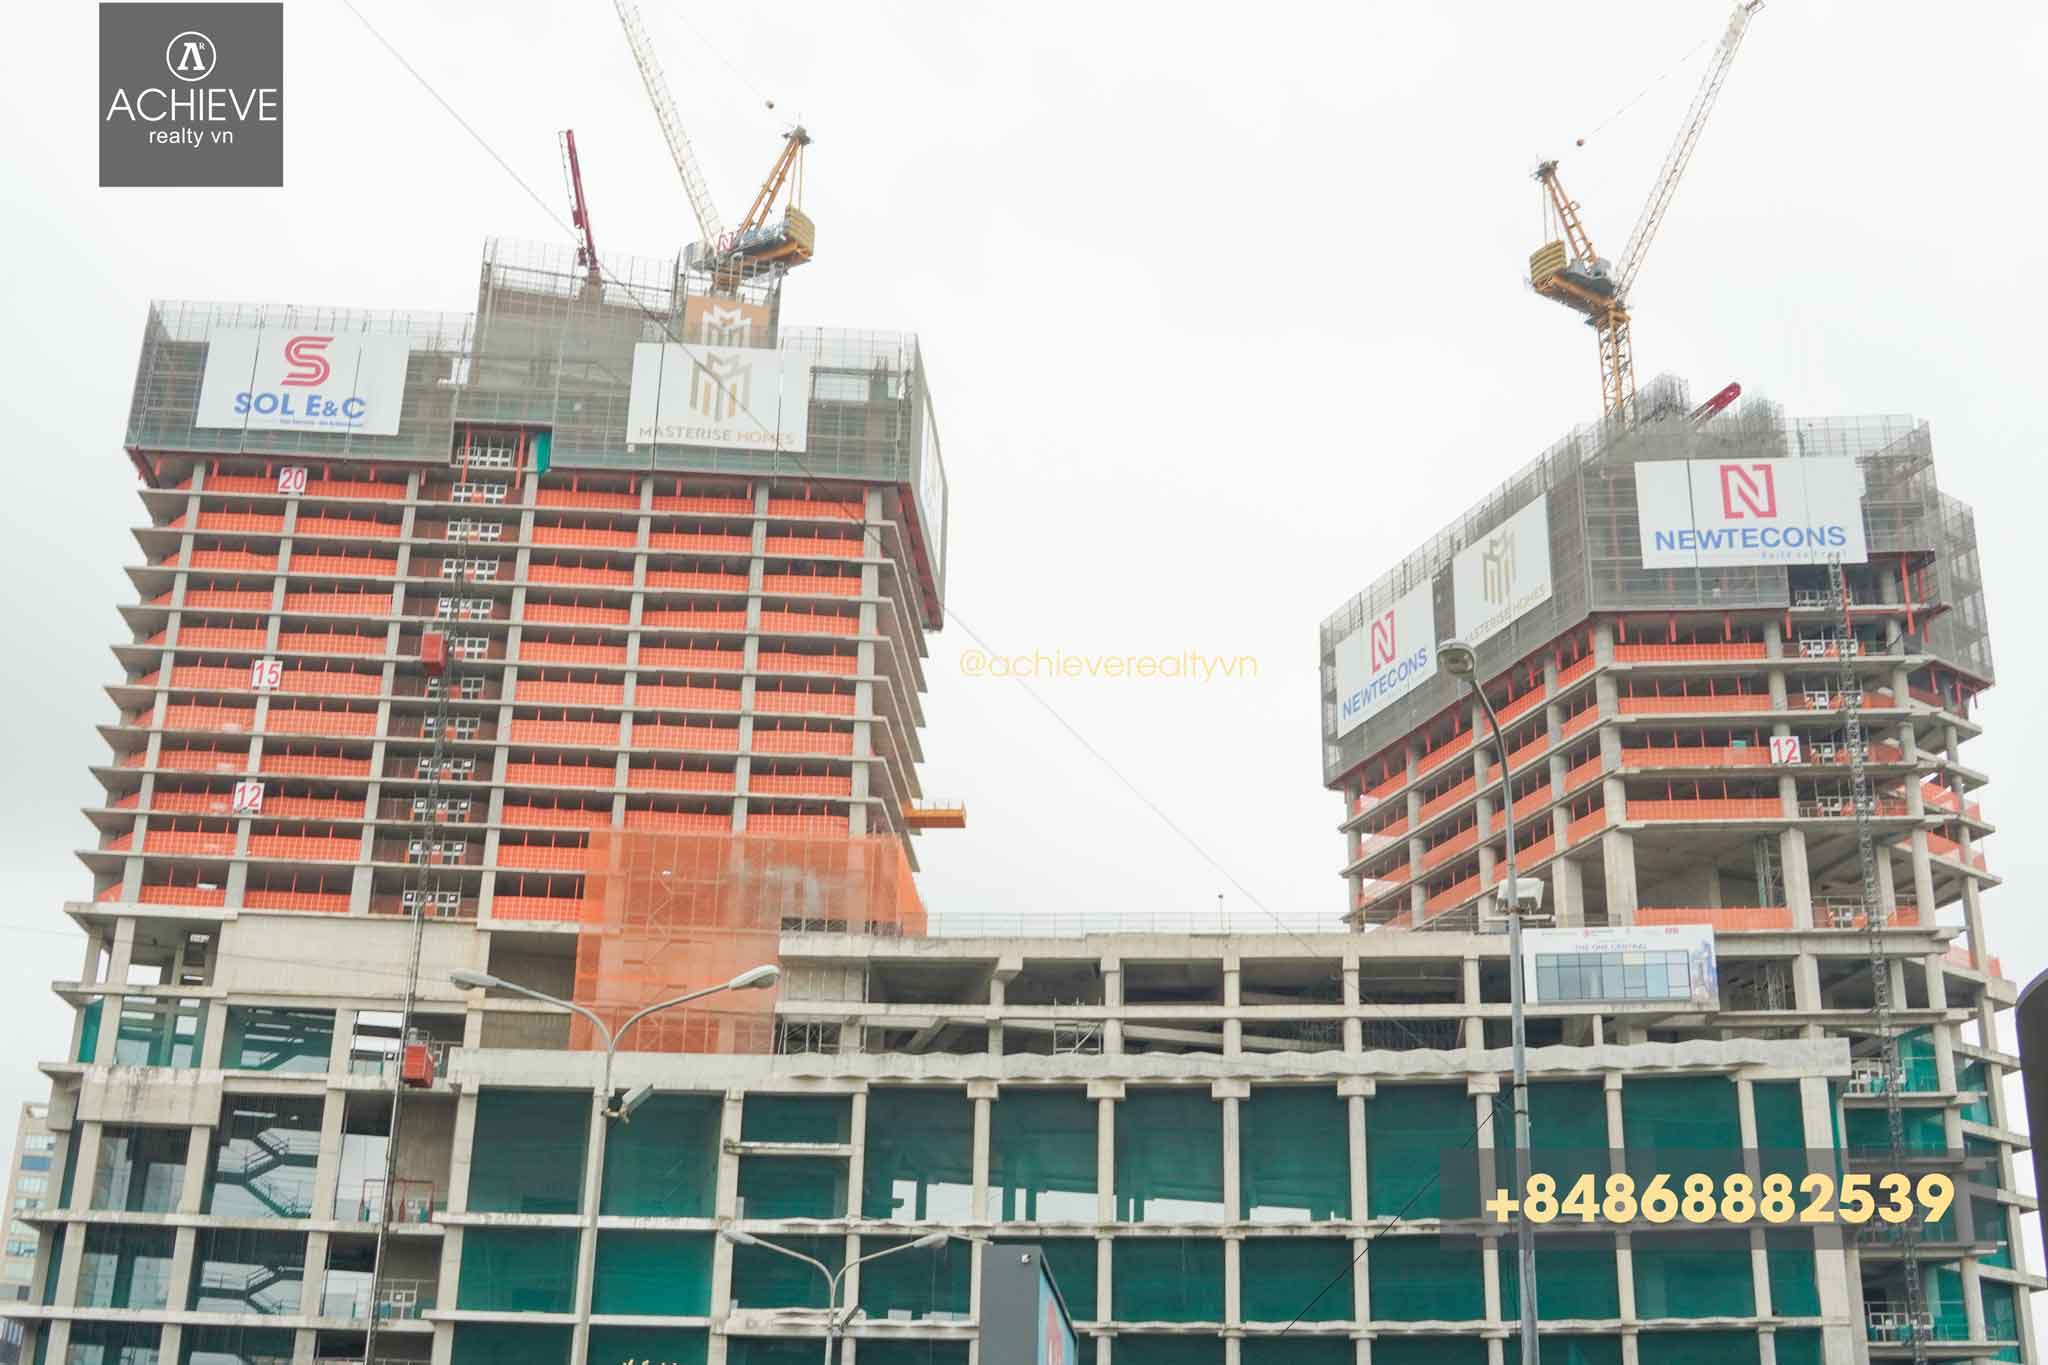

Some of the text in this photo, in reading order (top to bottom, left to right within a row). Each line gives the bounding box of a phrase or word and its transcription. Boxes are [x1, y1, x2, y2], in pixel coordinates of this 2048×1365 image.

[234, 391, 366, 418] SOL E&C
[639, 423, 732, 442] MASTERISE
[281, 468, 304, 490] 20
[1655, 525, 1847, 551] NEWTECONS
[255, 661, 279, 686] 15
[1342, 647, 1428, 720] NEWTECONS
[1772, 738, 1798, 762] 12
[238, 783, 261, 808] 12
